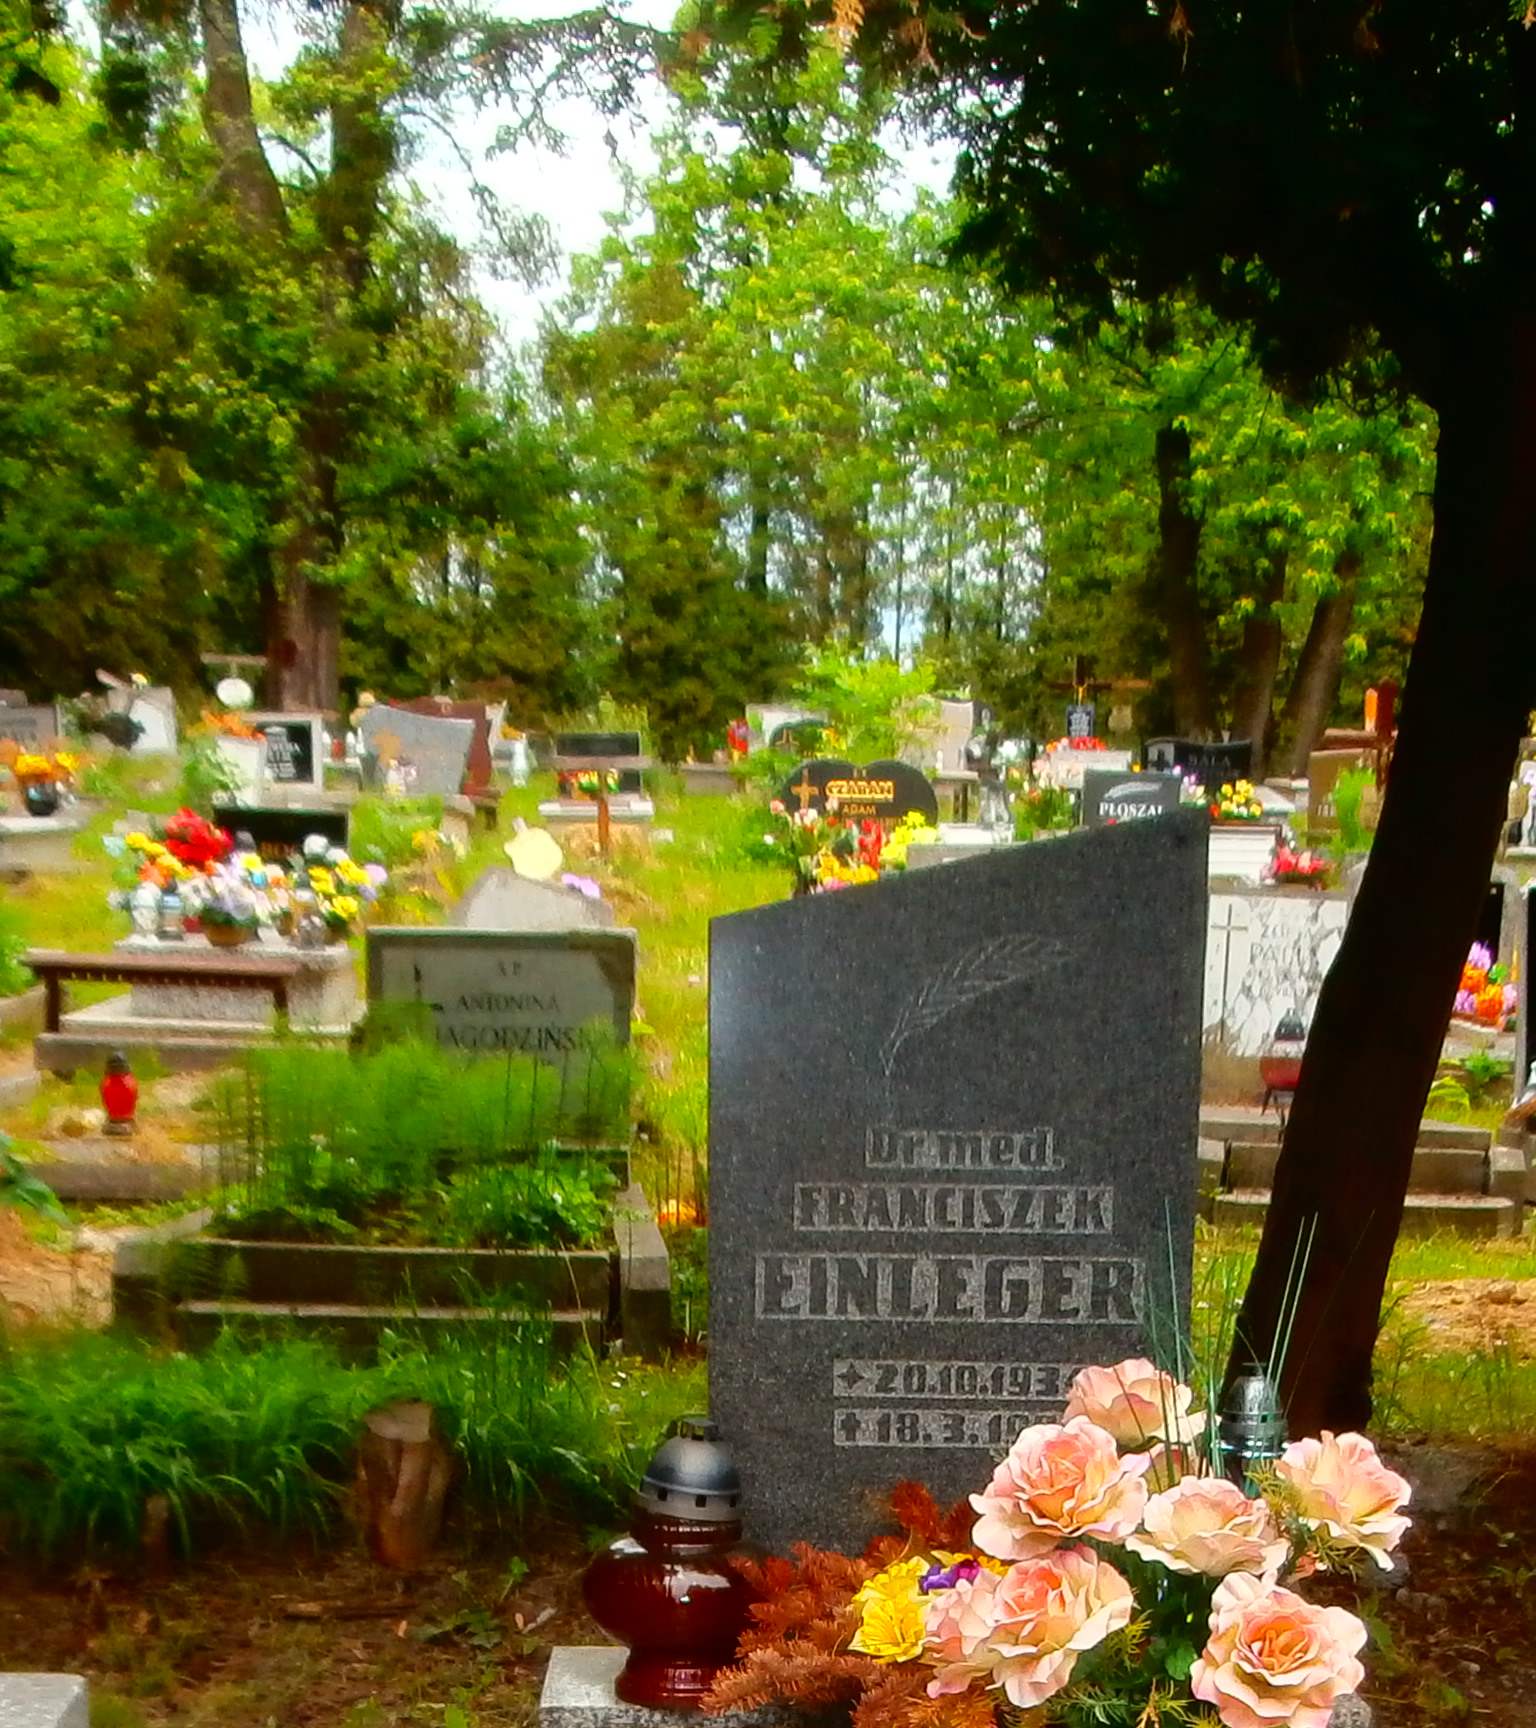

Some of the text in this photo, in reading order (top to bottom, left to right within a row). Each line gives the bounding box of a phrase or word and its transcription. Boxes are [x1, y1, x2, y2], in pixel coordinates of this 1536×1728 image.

[795, 1184, 1114, 1232] FRANCISZEK
[757, 1255, 1145, 1322] EINLEGER
[874, 1364, 1082, 1396] 20.10.193
